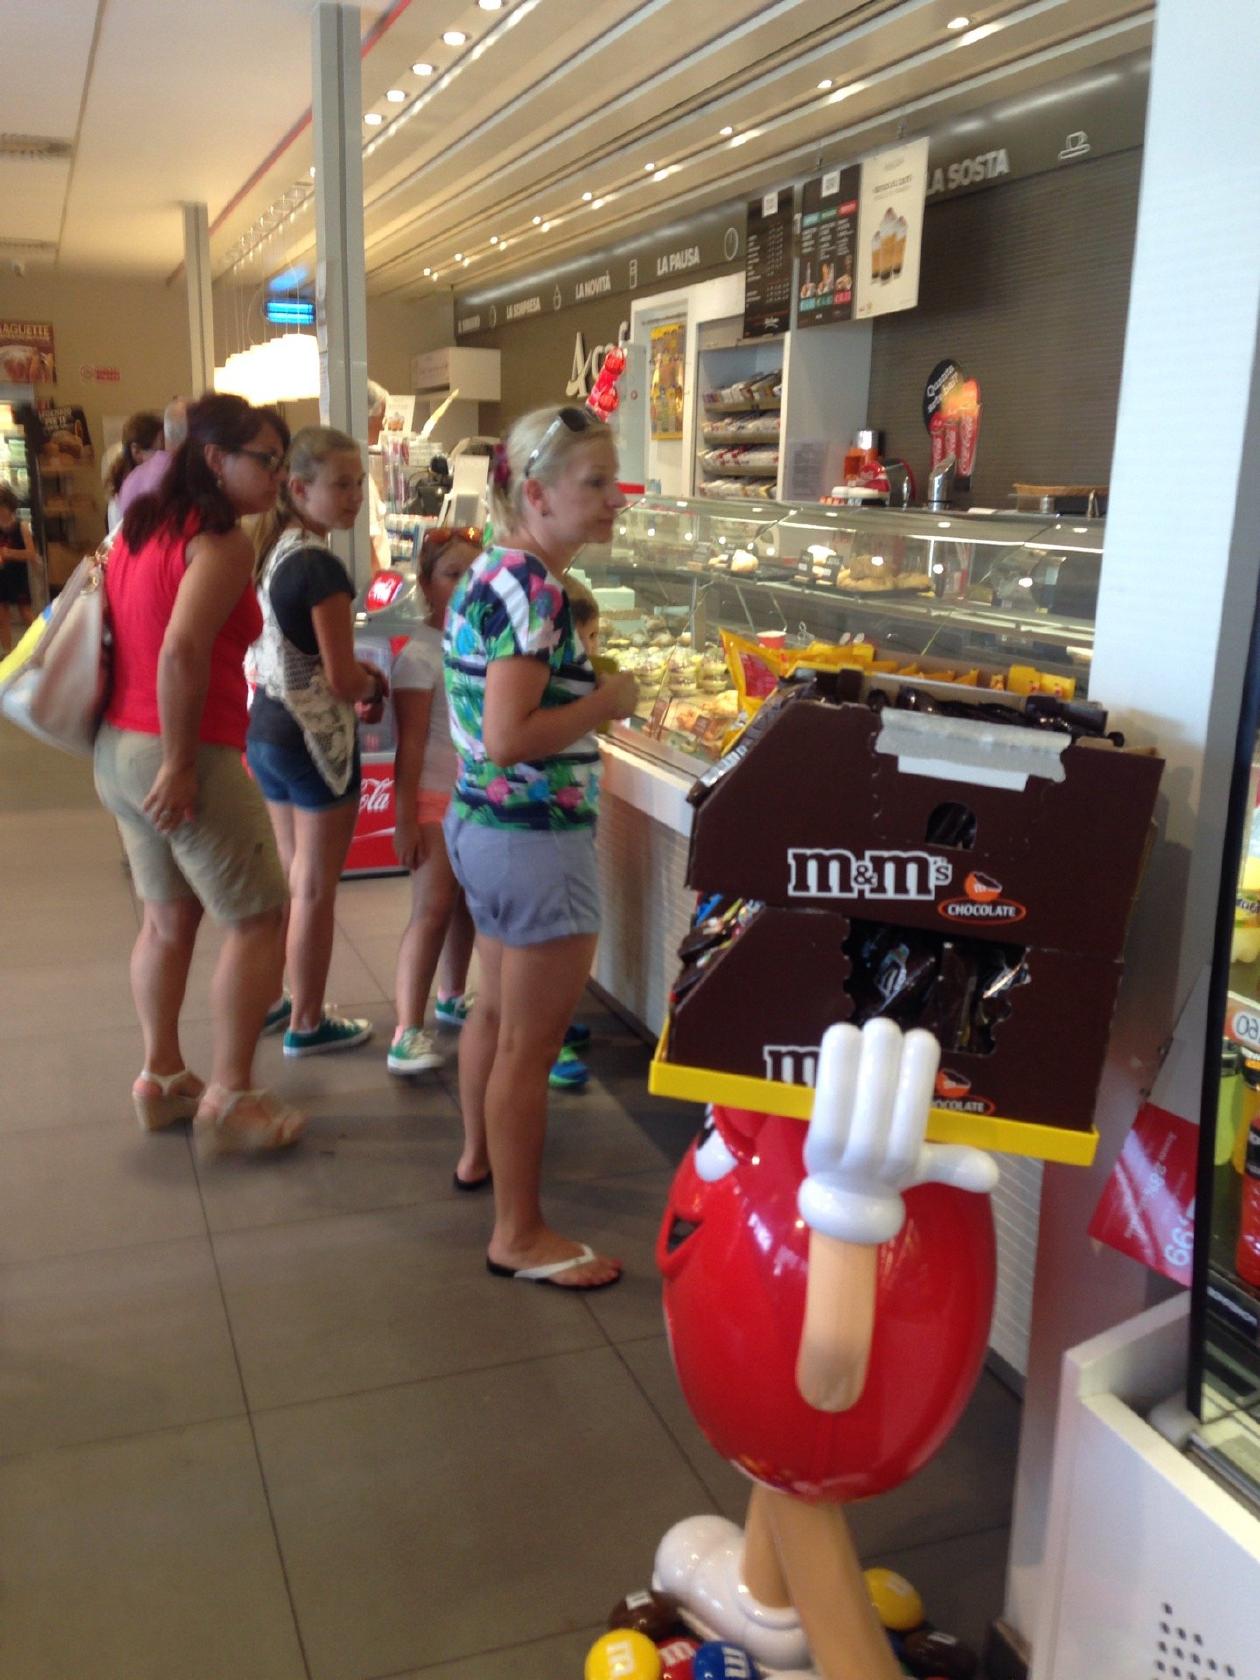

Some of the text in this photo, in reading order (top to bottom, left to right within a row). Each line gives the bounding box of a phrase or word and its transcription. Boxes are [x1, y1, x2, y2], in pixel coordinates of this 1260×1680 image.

[948, 149, 1010, 190] SOSTA
[656, 246, 700, 276] LA PAUSA
[947, 903, 1016, 917] CHOCOLATE
